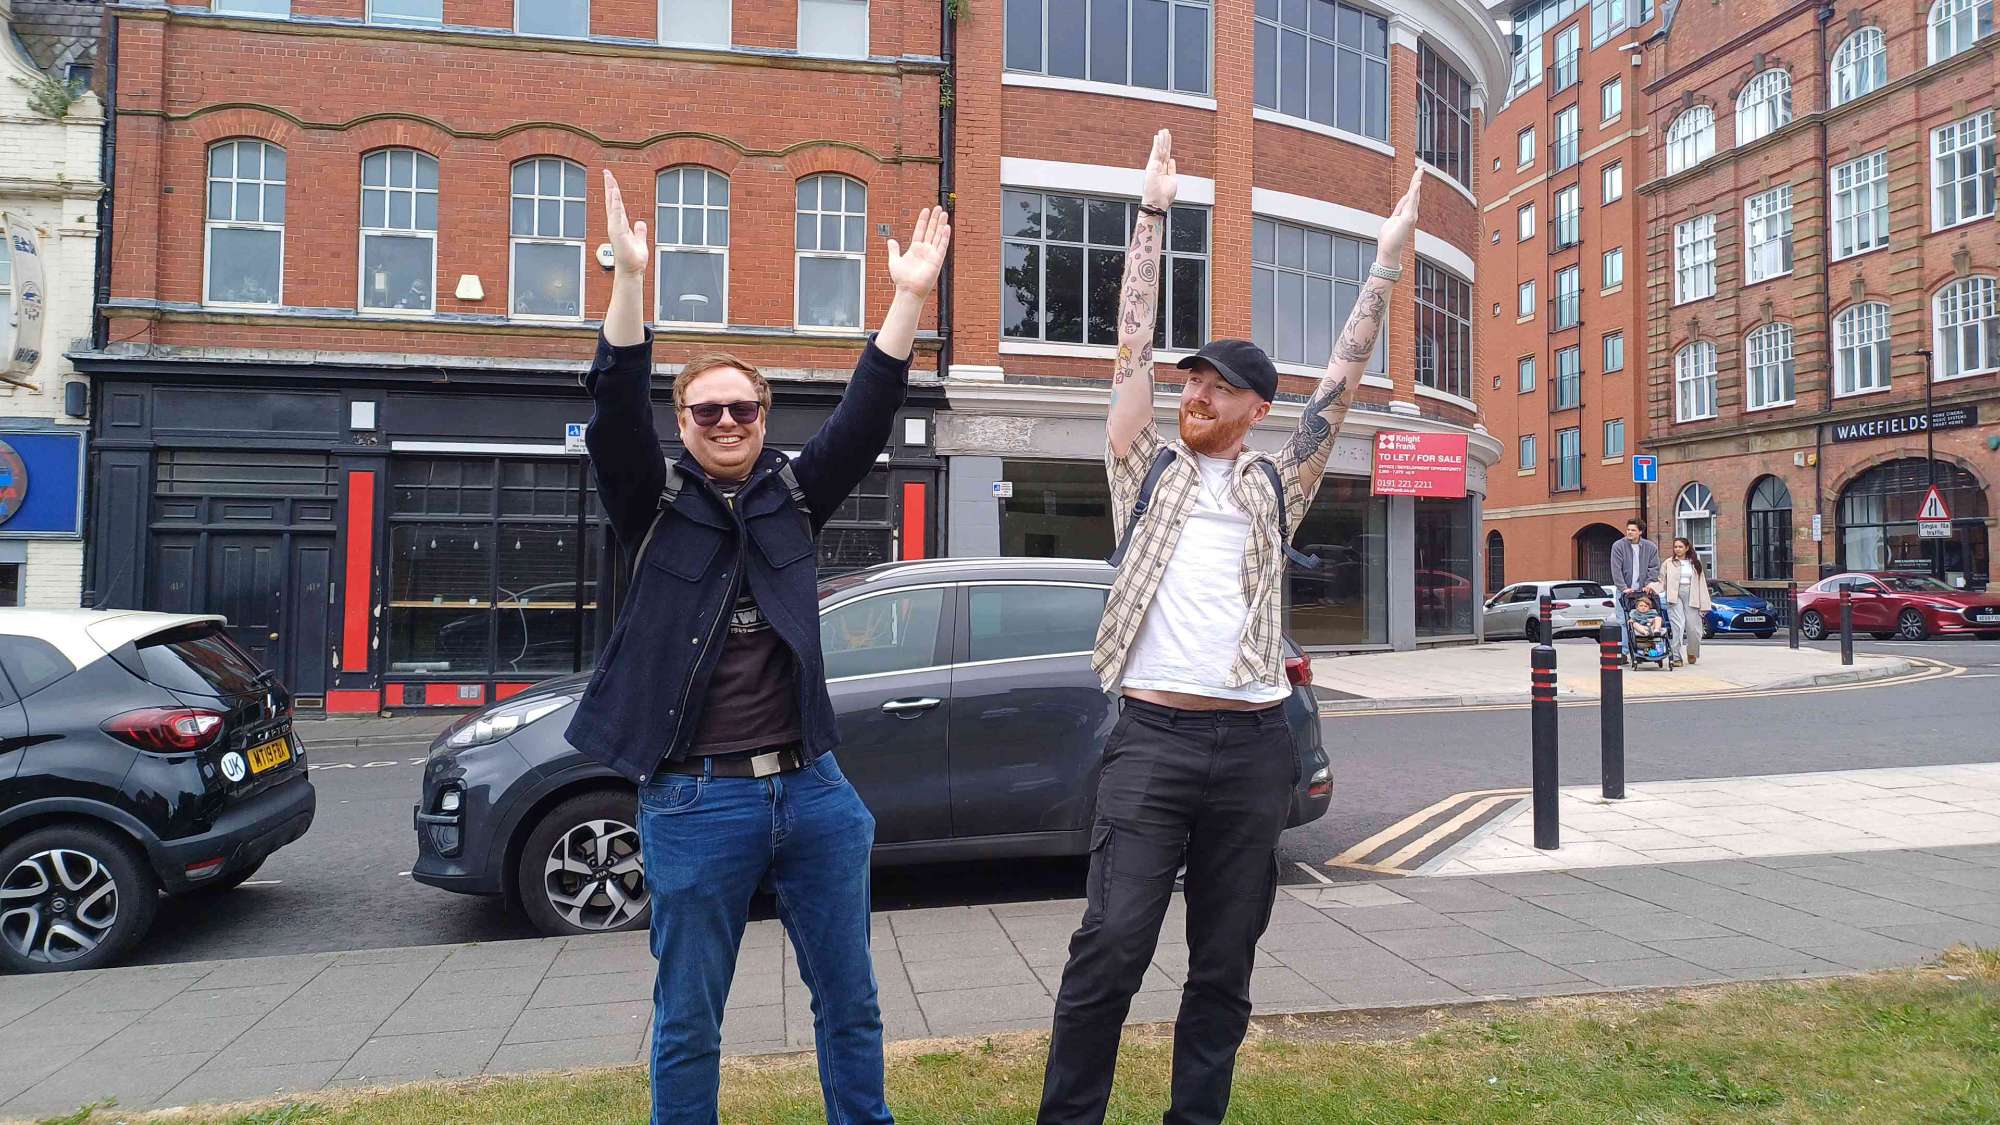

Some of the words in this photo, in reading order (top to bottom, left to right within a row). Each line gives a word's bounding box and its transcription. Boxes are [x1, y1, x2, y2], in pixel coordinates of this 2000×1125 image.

[1837, 414, 1928, 439] WAKEFIELDS
[1395, 434, 1420, 444] Knight
[1395, 442, 1416, 450] Frank
[1379, 453, 1392, 461] TO
[1393, 453, 1411, 461] LET
[1416, 454, 1436, 462] FOR
[1437, 455, 1462, 464] SALE
[1377, 479, 1395, 487] 0191
[1398, 480, 1412, 488] 221
[223, 756, 244, 776] UK
